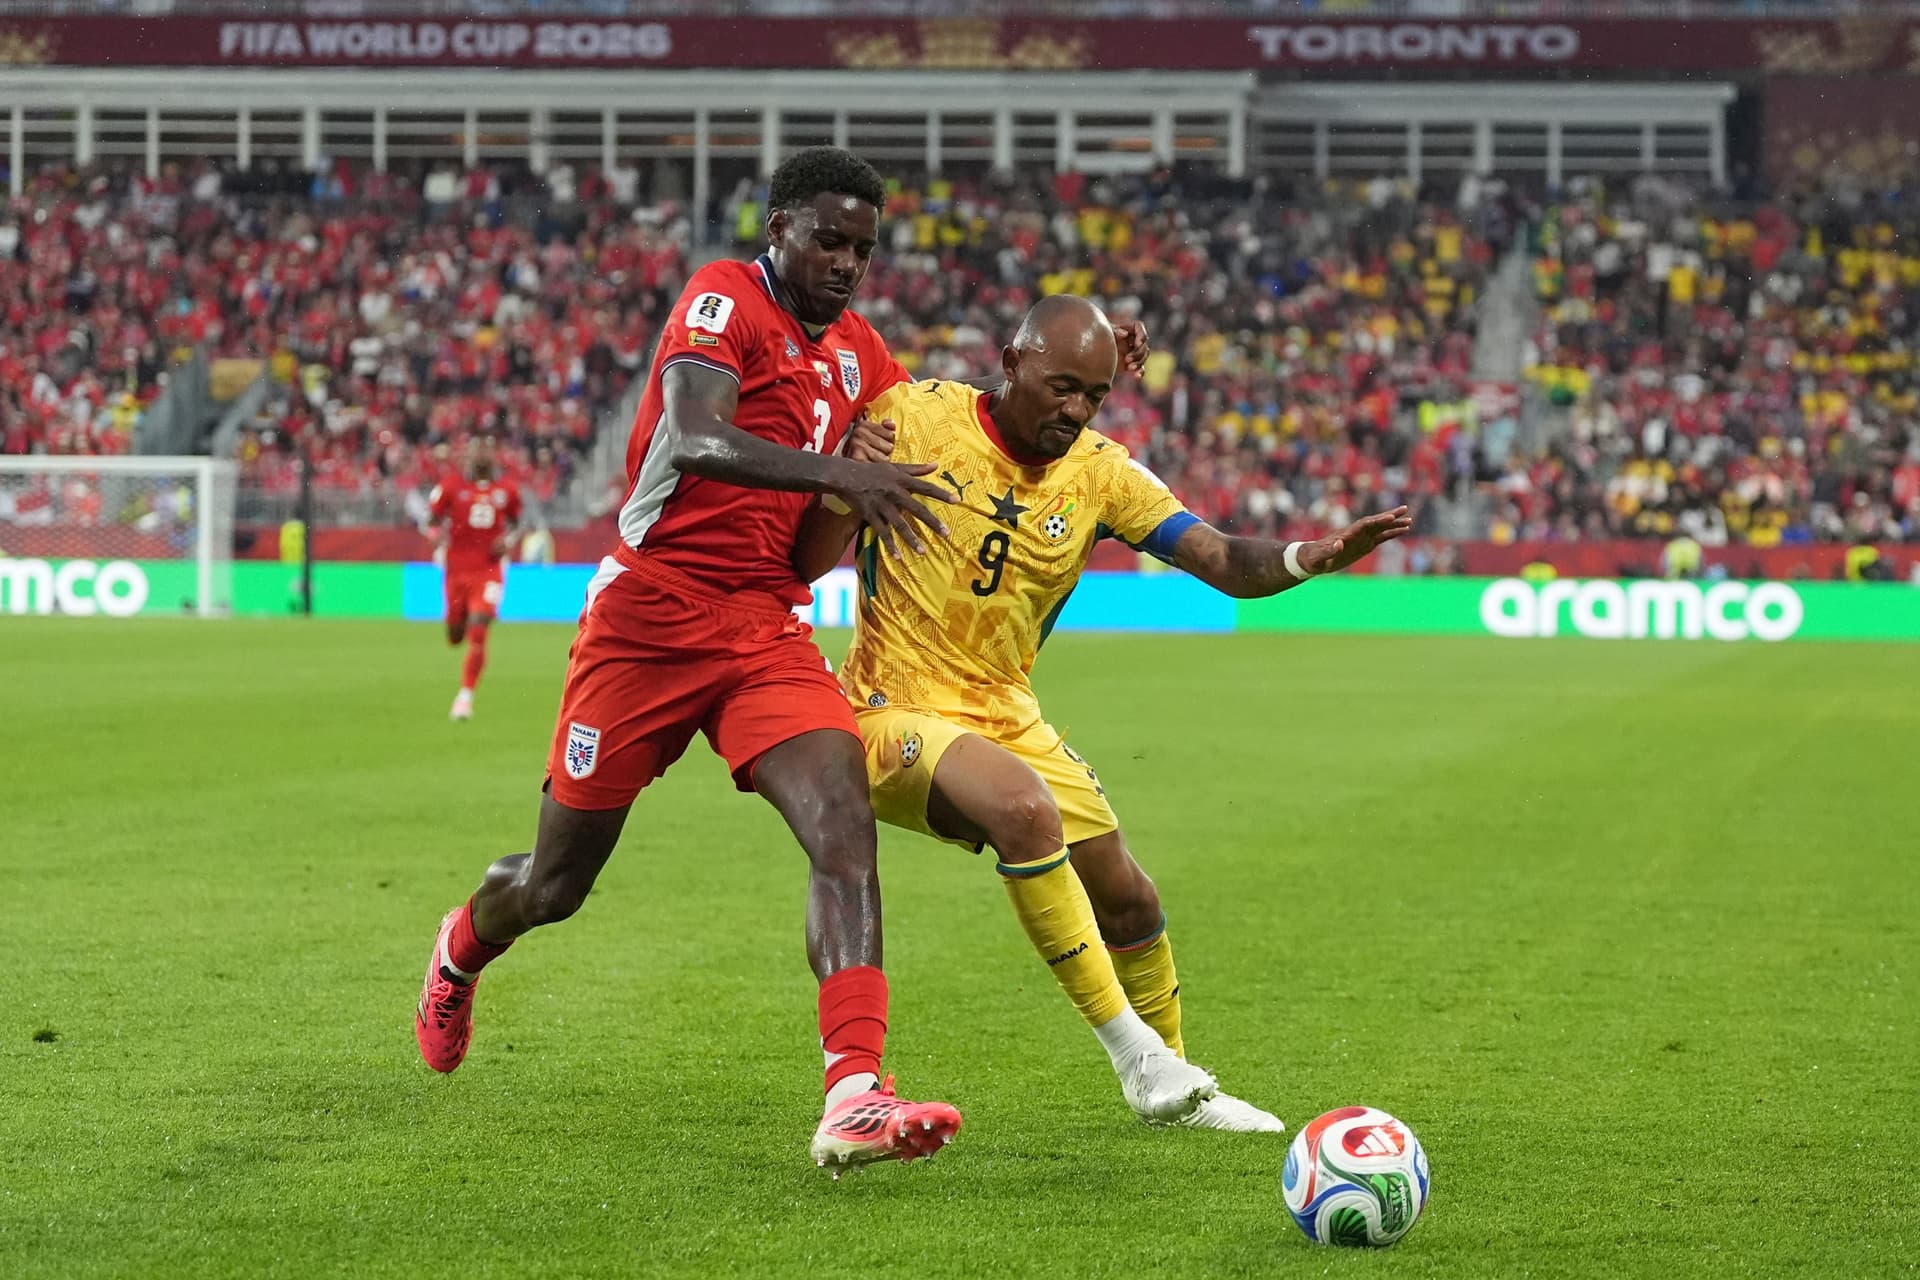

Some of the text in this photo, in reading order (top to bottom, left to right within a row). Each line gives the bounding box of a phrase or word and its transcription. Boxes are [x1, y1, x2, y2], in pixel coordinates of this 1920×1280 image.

[219, 22, 673, 59] FIFA WORLD CUP 2026
[1250, 25, 1579, 59] TORONTO
[802, 399, 832, 454] 3
[971, 530, 1010, 597] 9
[1479, 578, 1804, 642] aramco
[572, 725, 597, 739] PANAMA
